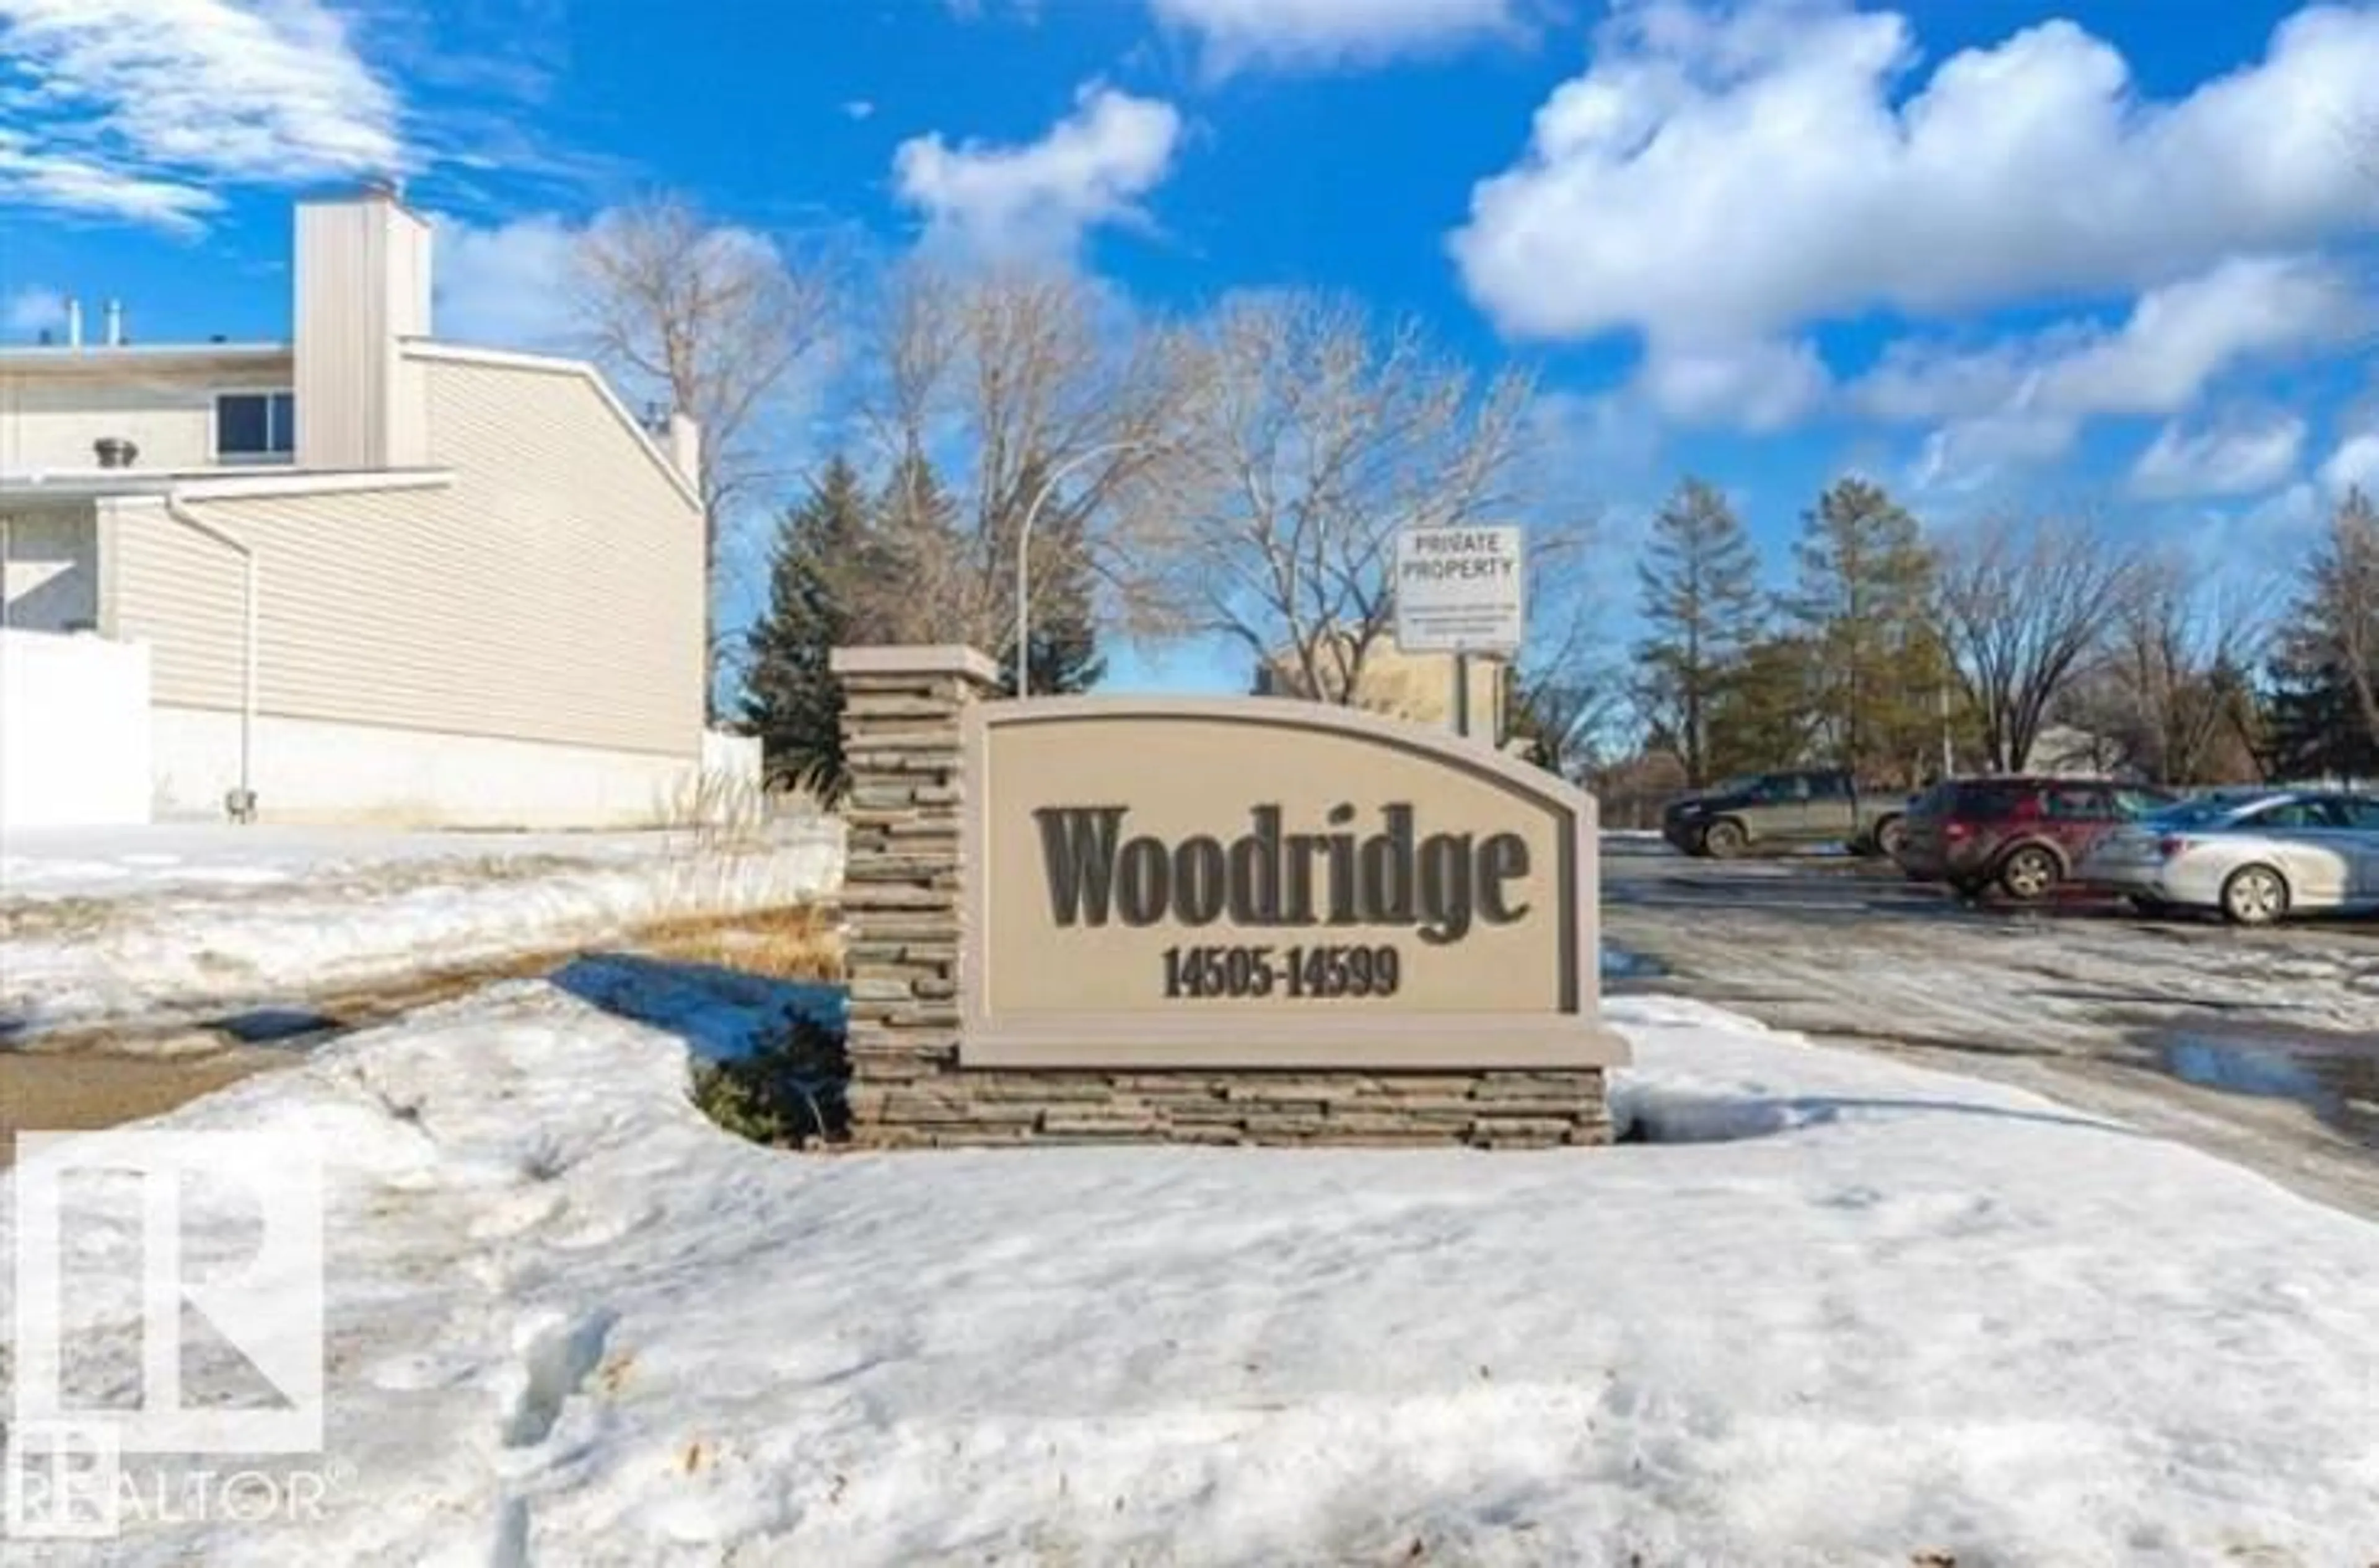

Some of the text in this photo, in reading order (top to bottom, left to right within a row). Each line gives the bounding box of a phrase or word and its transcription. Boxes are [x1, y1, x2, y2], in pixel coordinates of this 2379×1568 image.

[1415, 532, 1500, 555] PRIVATE
[1401, 557, 1517, 580] PROPERTY
[1033, 803, 1531, 945] Woodridge
[1162, 945, 1400, 999] 14505-14599
